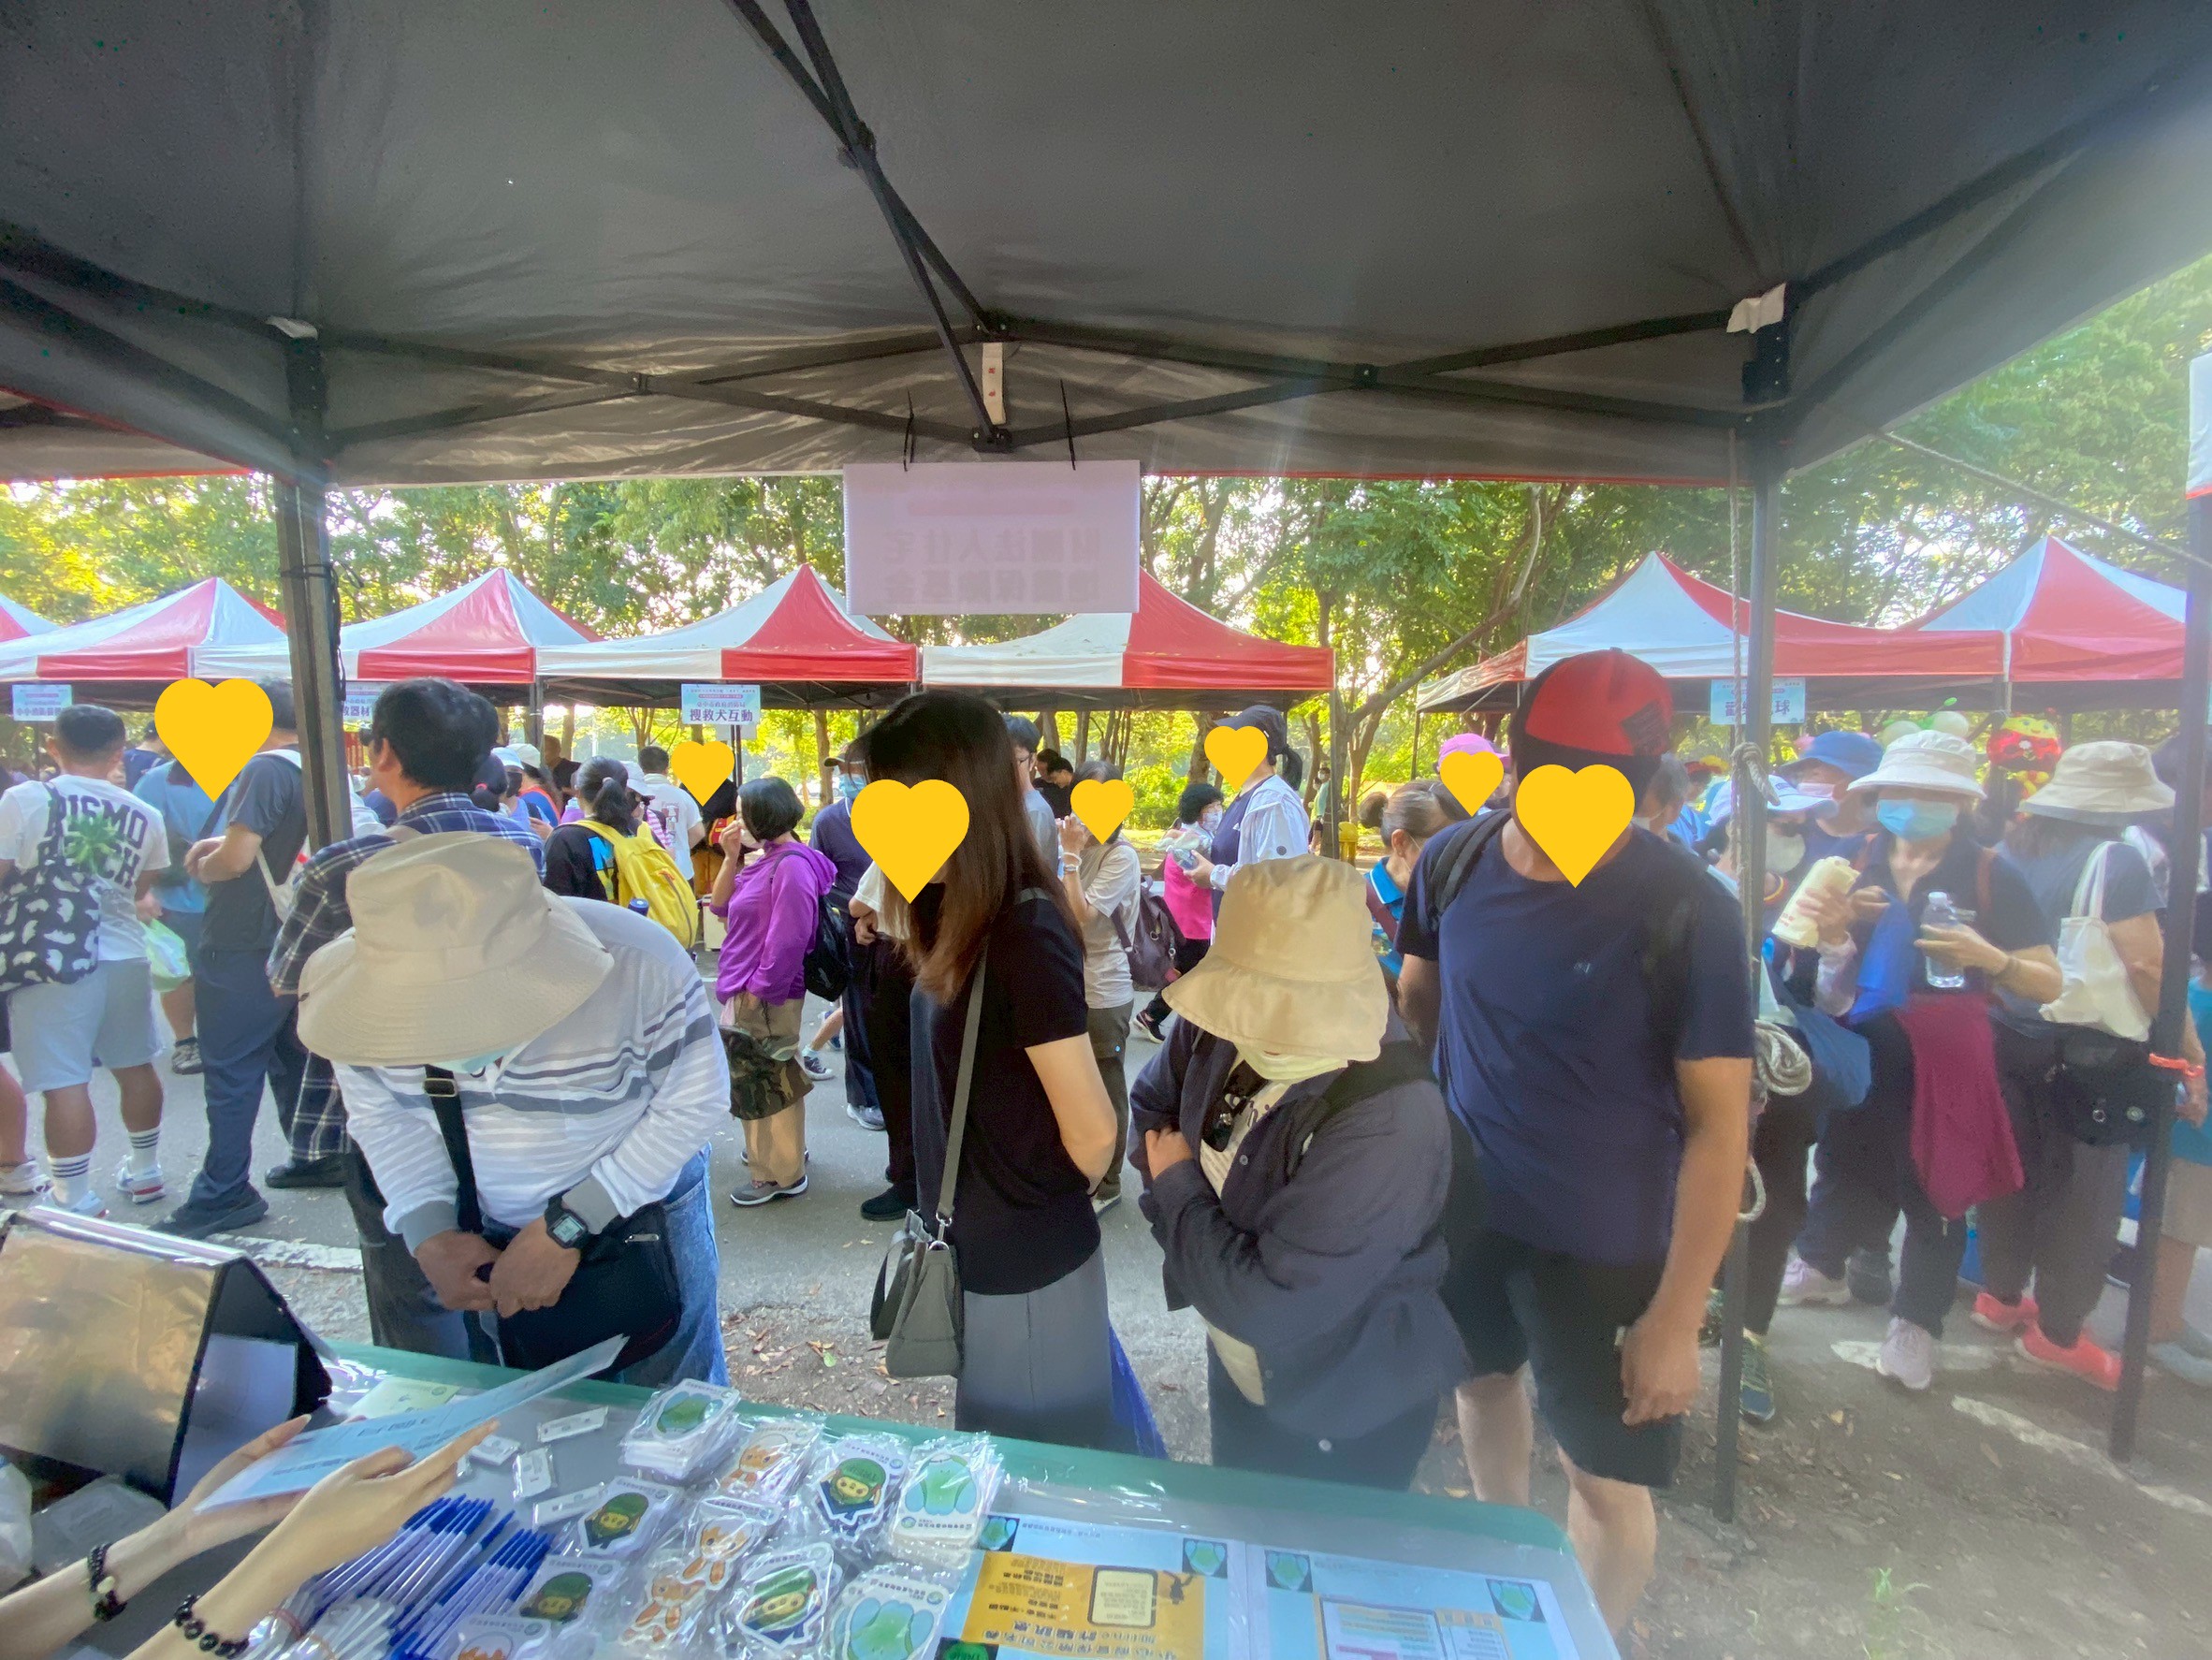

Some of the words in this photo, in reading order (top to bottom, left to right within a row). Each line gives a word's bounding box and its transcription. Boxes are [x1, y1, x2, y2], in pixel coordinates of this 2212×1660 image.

[690, 708, 753, 722] 搜救犬互動
